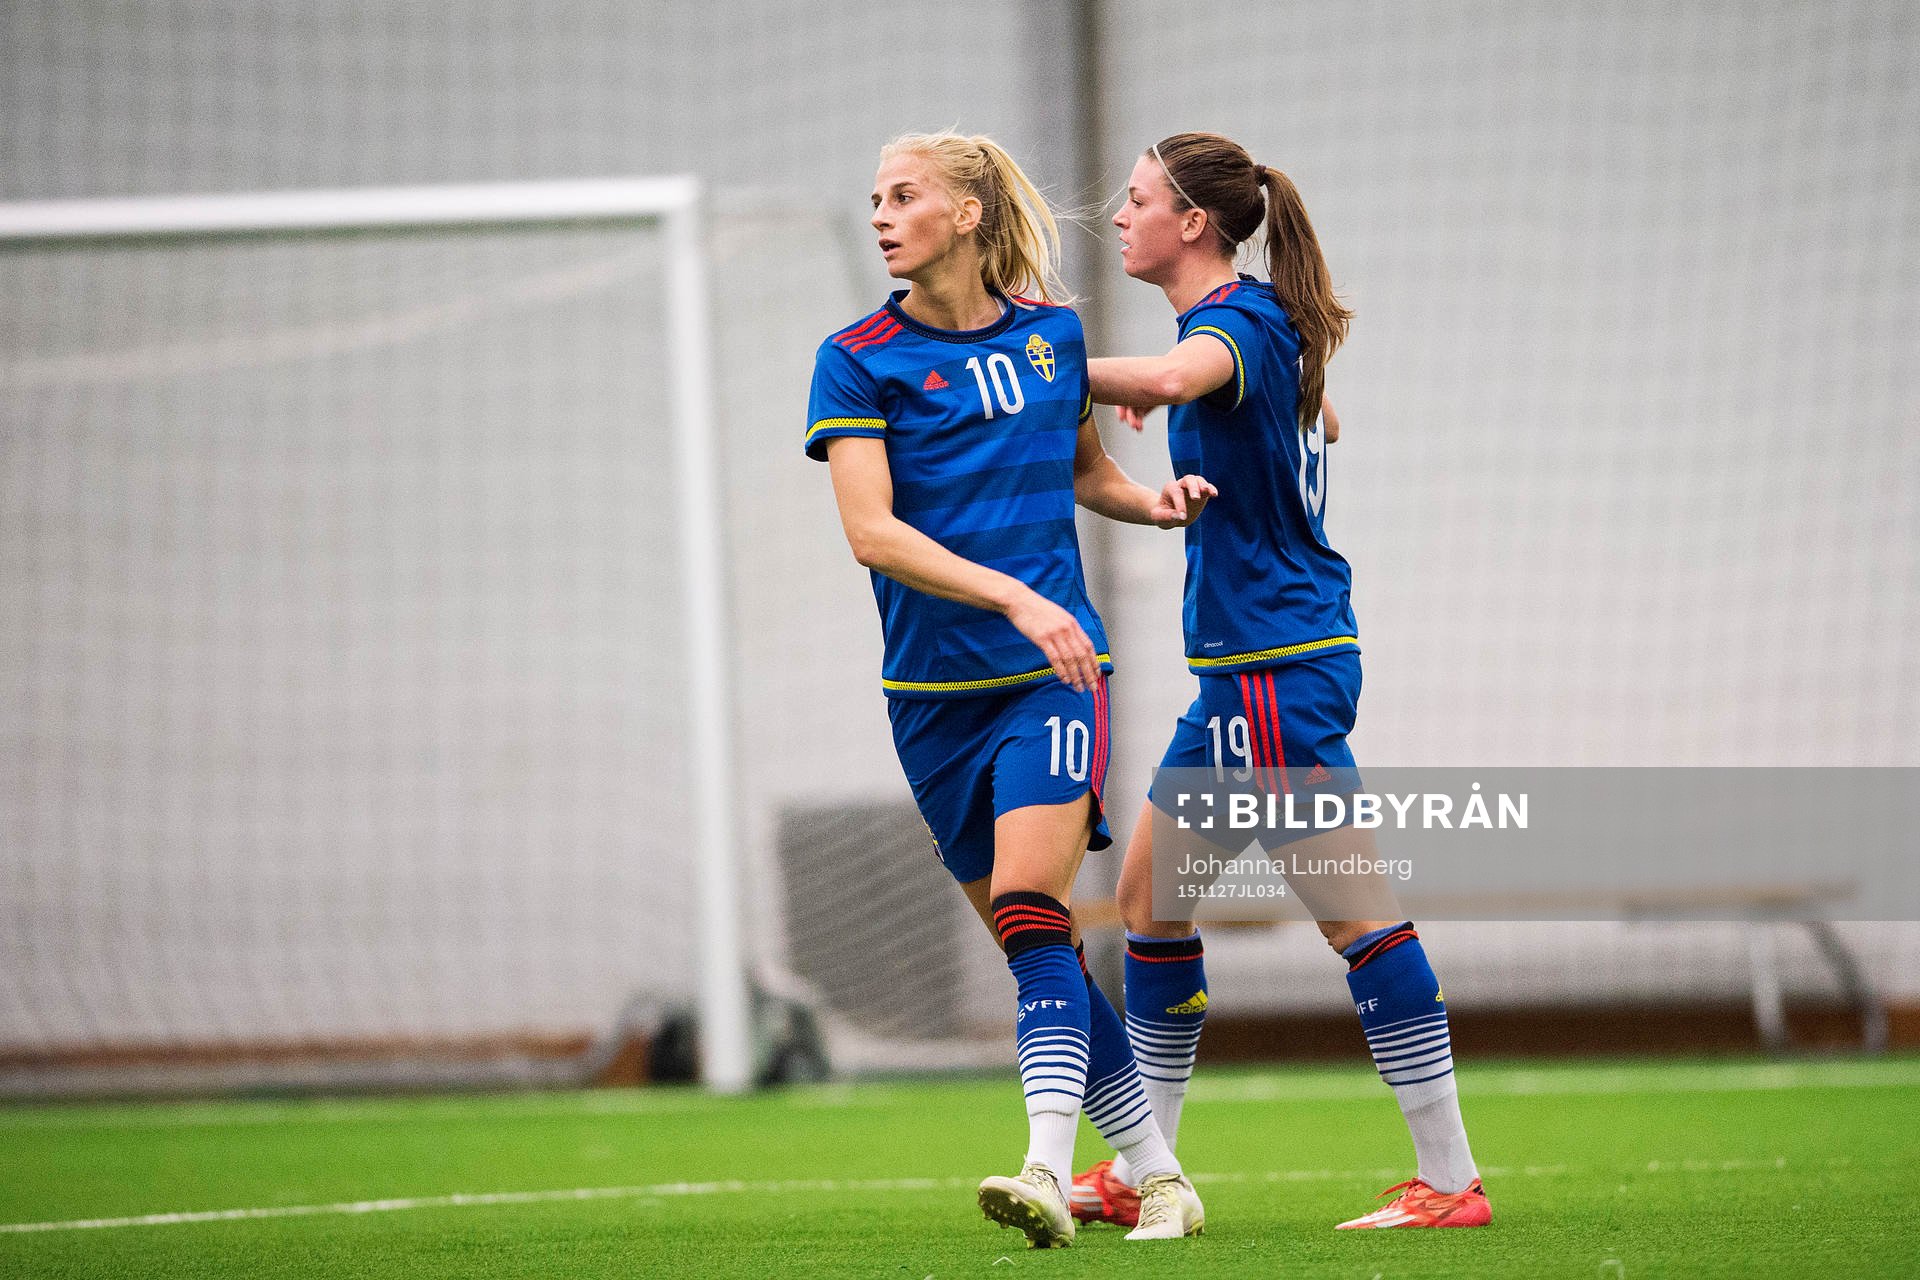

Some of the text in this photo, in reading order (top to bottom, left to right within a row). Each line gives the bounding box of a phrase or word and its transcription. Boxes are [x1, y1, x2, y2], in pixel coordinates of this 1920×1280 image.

[965, 353, 1025, 420] 10
[1043, 715, 1089, 782] 10
[1207, 715, 1253, 783] 19
[1018, 1000, 1067, 1022] SVFF
